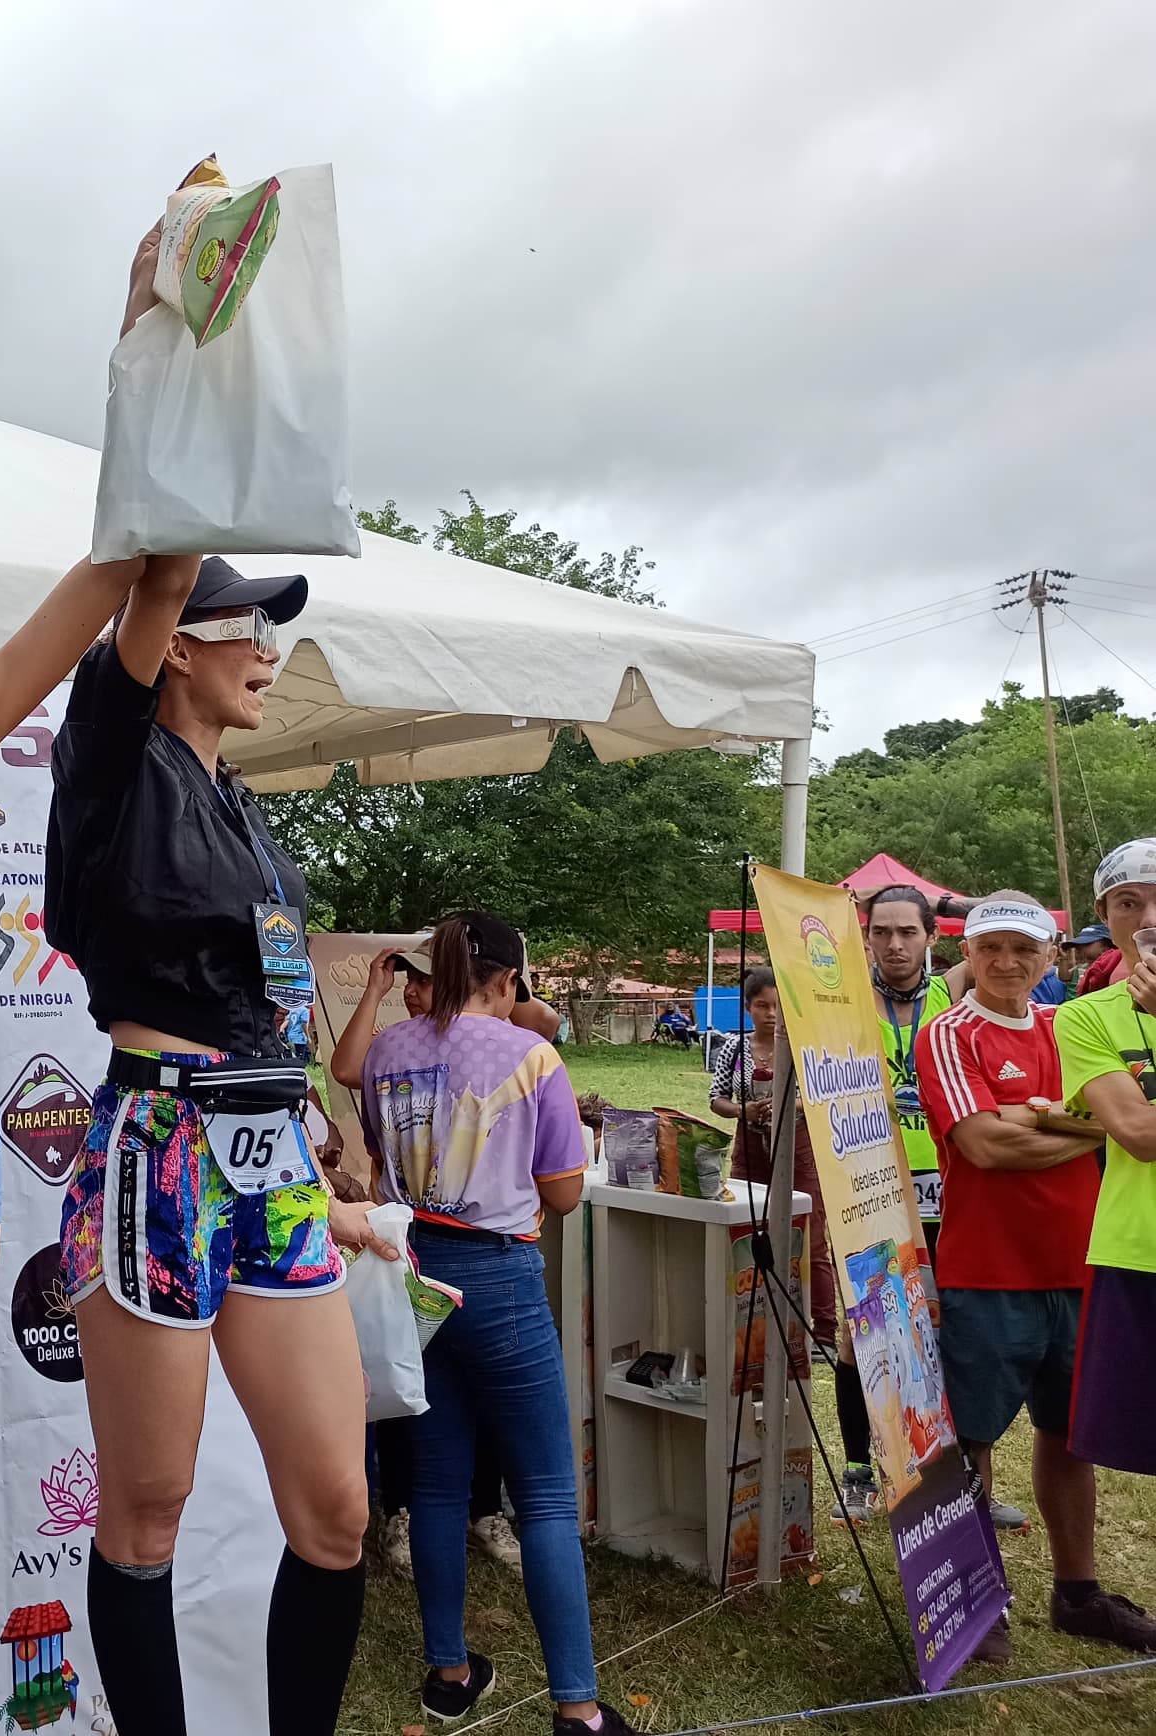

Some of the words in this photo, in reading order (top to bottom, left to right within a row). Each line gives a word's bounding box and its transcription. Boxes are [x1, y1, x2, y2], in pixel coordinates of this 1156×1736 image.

[13, 842, 45, 855] ATLE
[282, 962, 304, 970] LUGAR
[0, 994, 16, 1007] DE
[20, 993, 73, 1006] NIRGUA
[998, 1070, 1027, 1080] adidas
[7, 1108, 90, 1130] PARAPENTES
[229, 1125, 285, 1169] 05
[850, 1168, 880, 1193] Ideales
[879, 1165, 898, 1189] para
[841, 1192, 880, 1225] compartir
[881, 1193, 892, 1209] en
[22, 1325, 60, 1346] 1000
[37, 1344, 75, 1362] Deluxe
[897, 1522, 923, 1561] Línea
[922, 1511, 936, 1541] de
[934, 1489, 975, 1531] Cereales
[12, 1541, 82, 1578] Avy's
